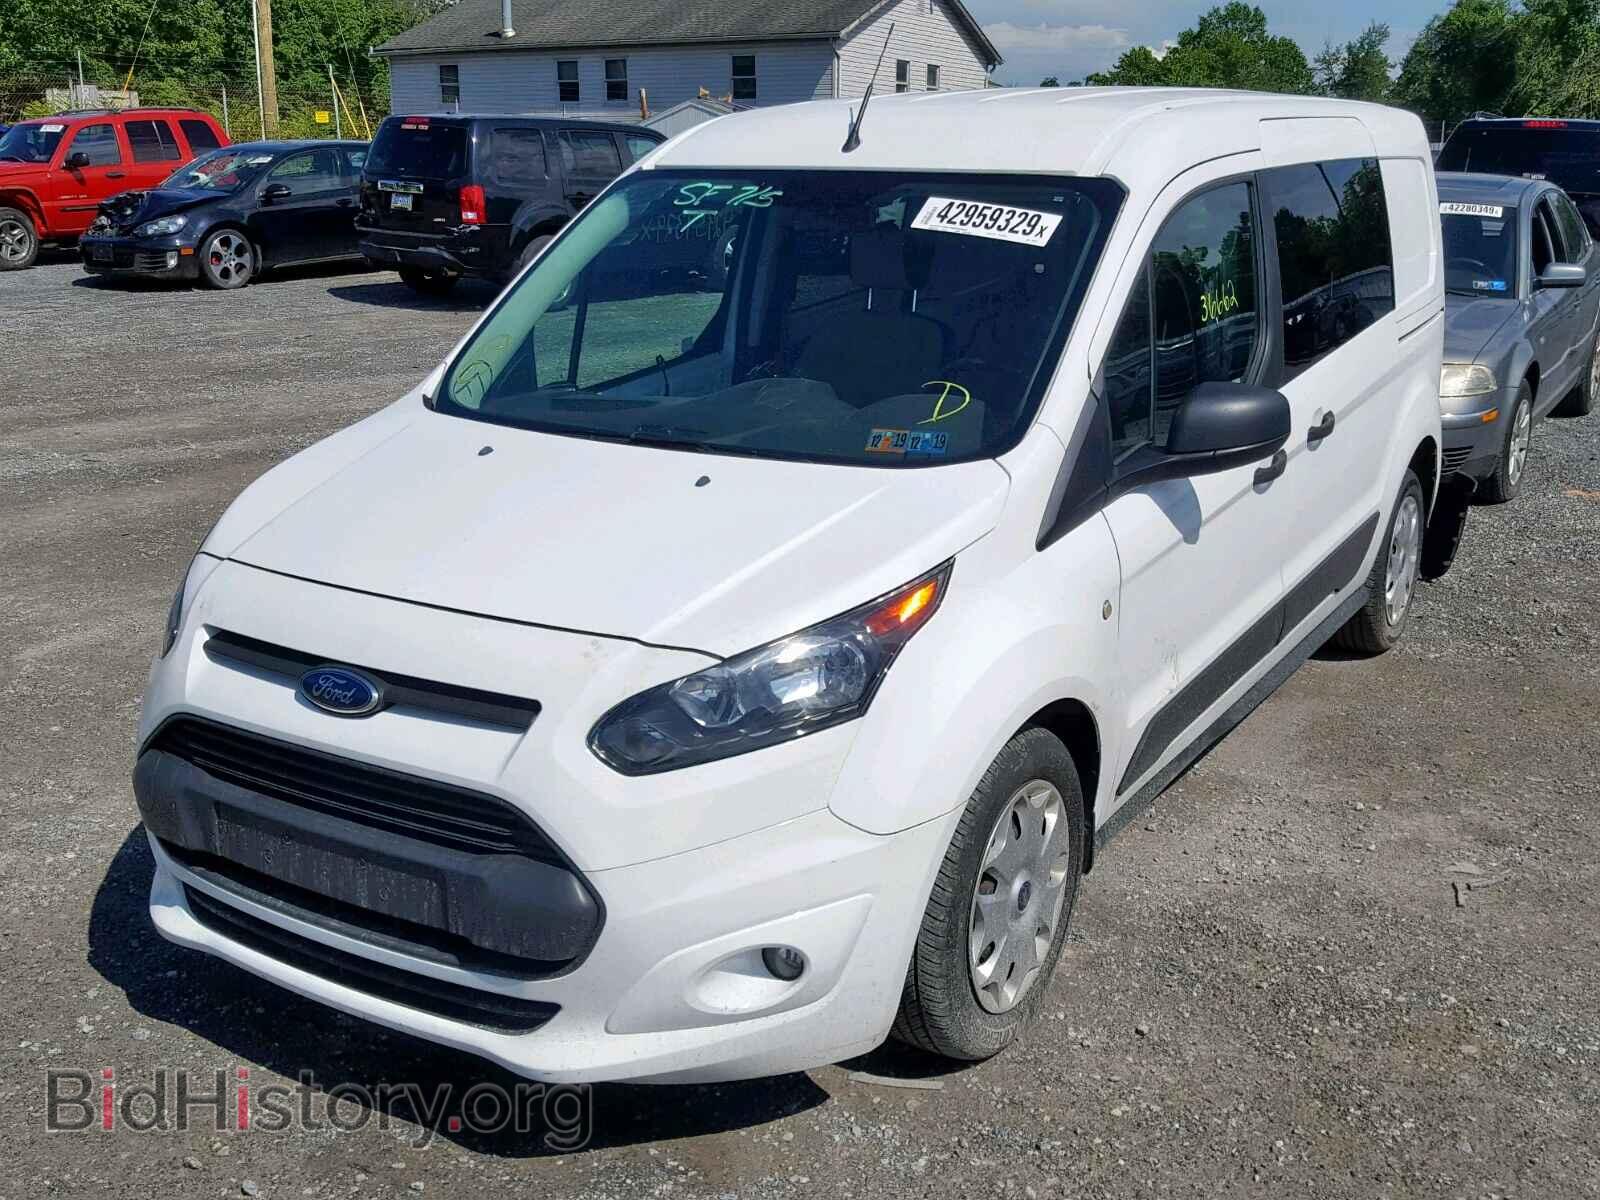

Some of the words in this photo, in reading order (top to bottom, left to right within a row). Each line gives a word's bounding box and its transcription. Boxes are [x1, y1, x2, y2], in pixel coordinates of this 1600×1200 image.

[916, 380, 971, 425] D
[870, 433, 882, 449] 12
[894, 432, 908, 448] 19
[910, 435, 921, 450] 12
[933, 432, 947, 449] 19
[312, 674, 357, 704] Ford
